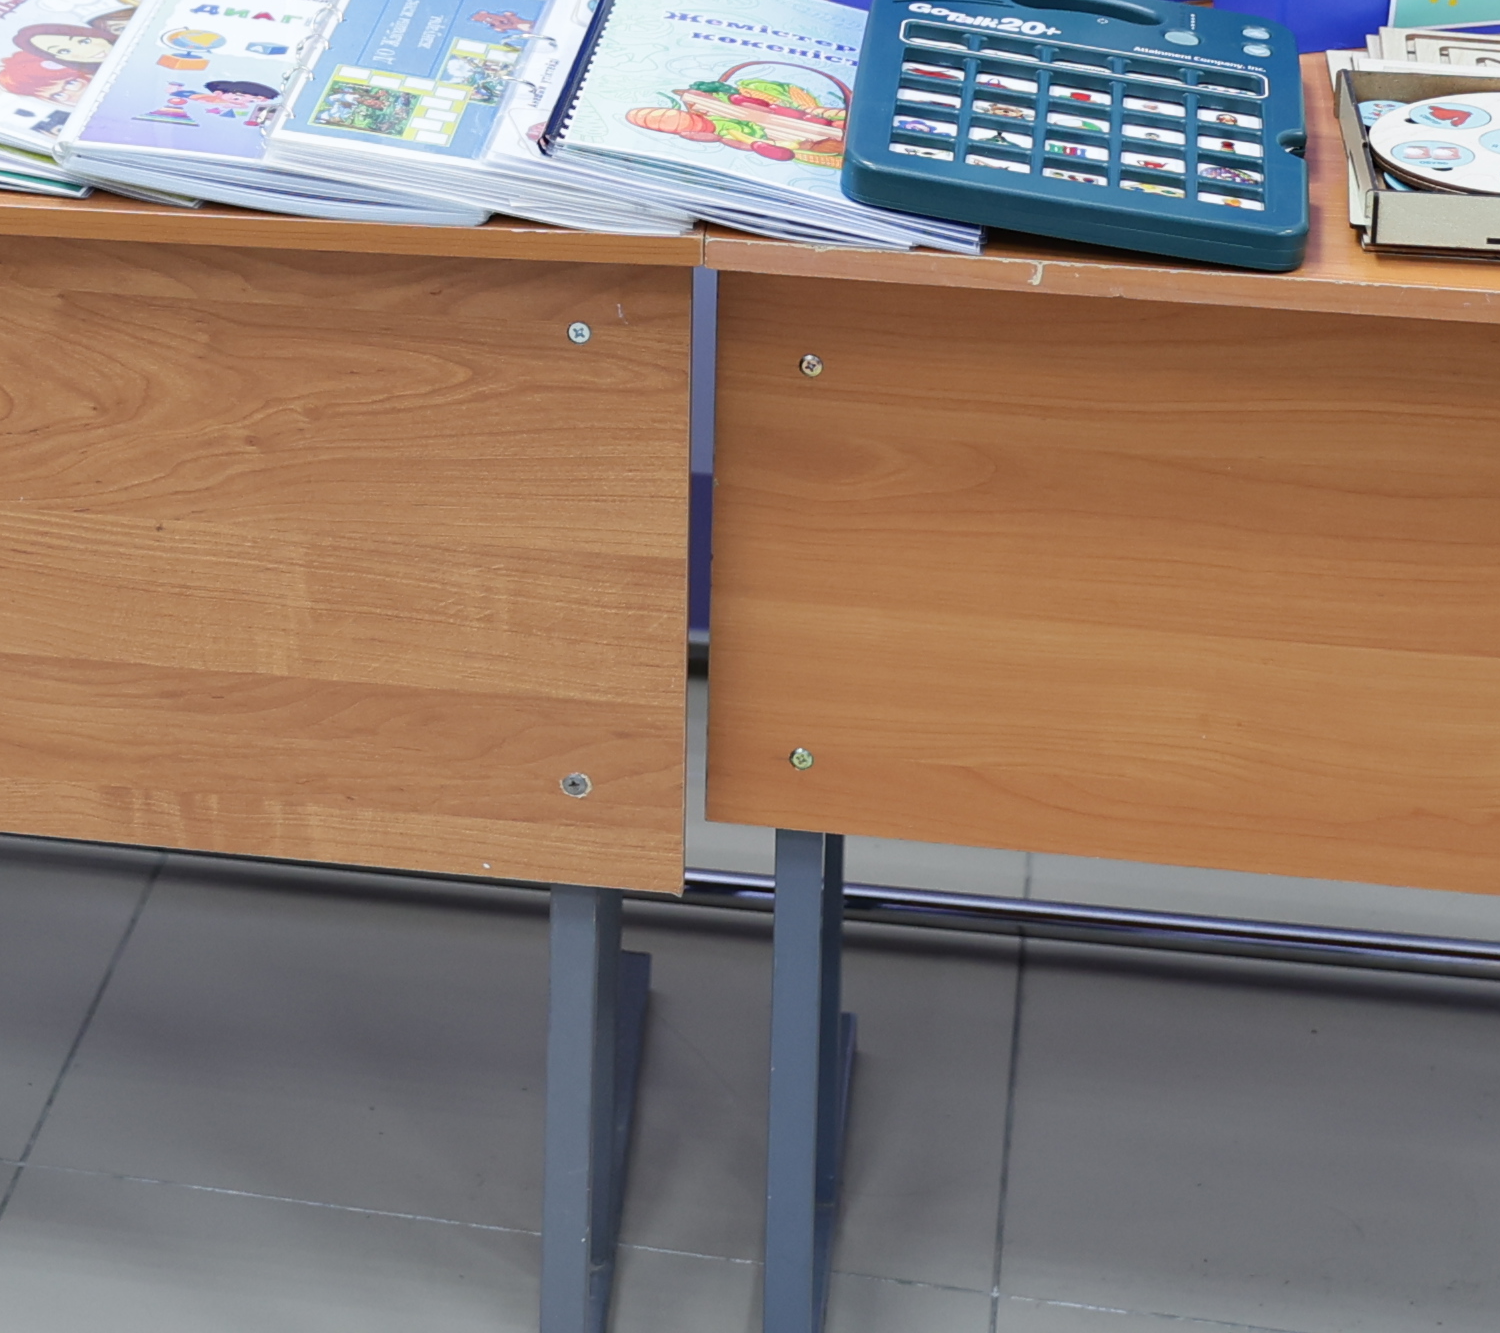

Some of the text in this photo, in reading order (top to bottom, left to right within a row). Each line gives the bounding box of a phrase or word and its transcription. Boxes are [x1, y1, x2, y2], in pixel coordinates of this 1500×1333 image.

[663, 9, 857, 54] Жемістер
[1133, 45, 1267, 73] Attainment Company, Inc.
